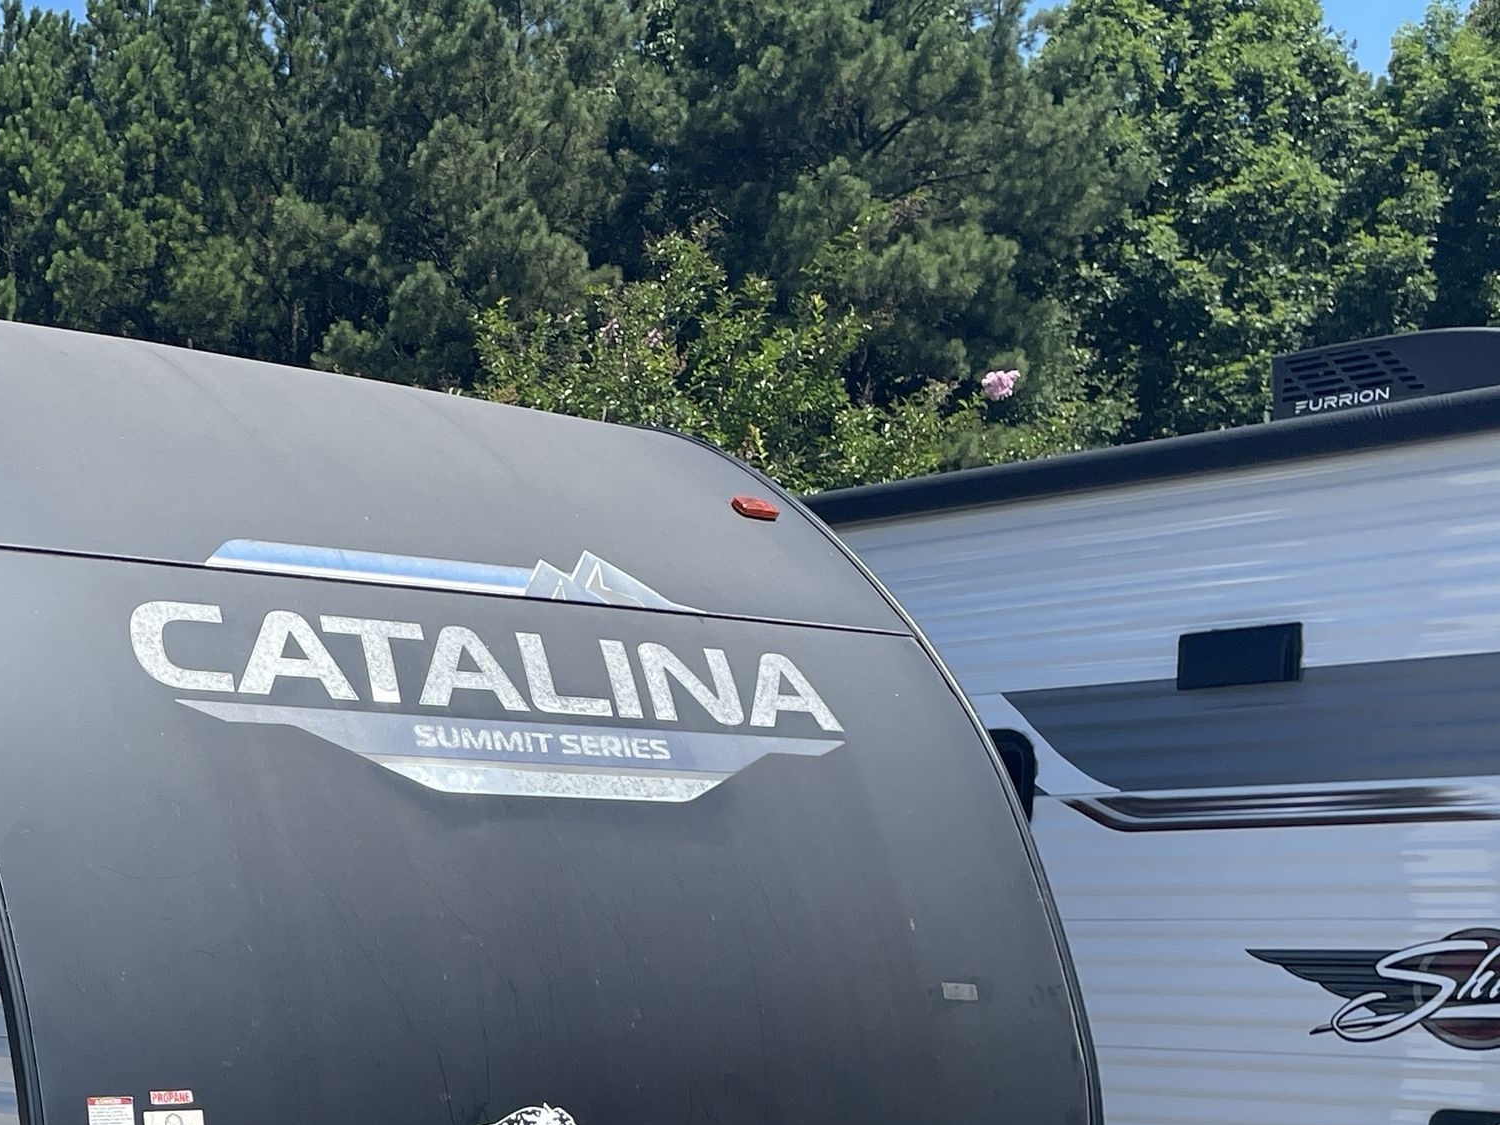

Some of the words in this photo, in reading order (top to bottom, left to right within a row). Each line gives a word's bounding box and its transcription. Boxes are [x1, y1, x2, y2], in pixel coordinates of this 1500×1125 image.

[1295, 386, 1390, 415] FURRION
[128, 600, 845, 732] CATALINA
[414, 723, 553, 753] SUMMIT
[559, 734, 671, 760] SERIES
[152, 1092, 190, 1104] PROPANE
